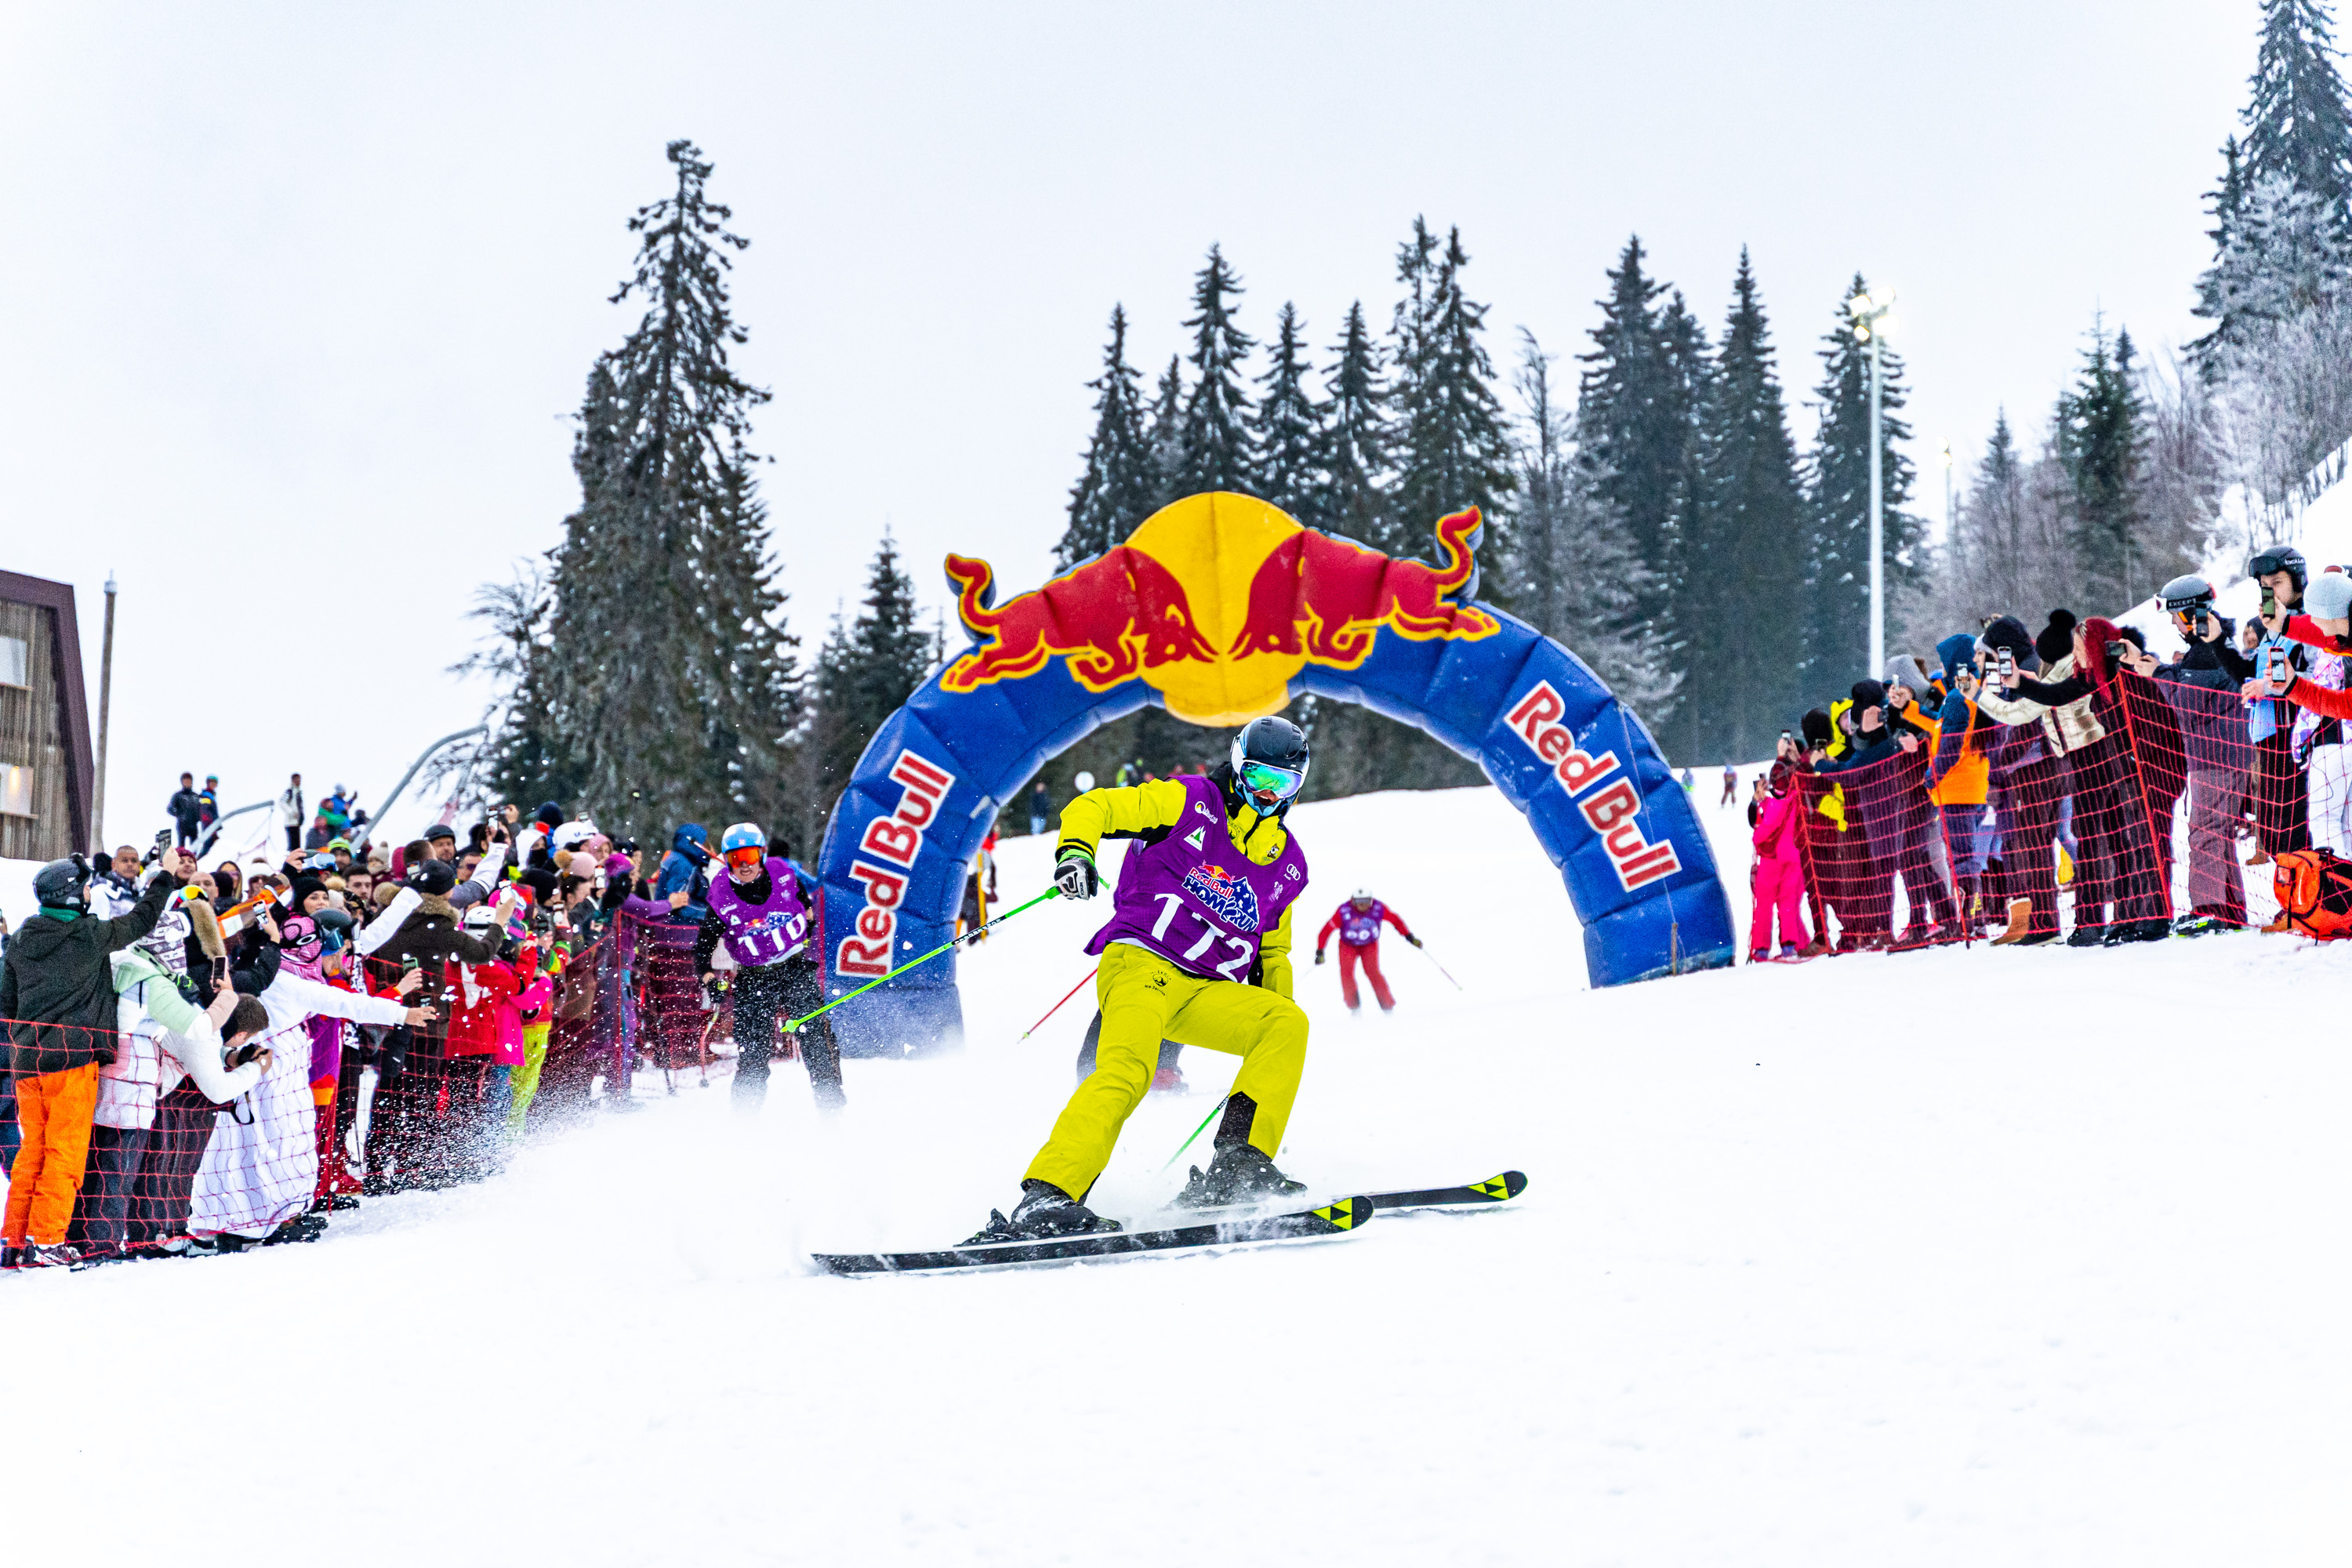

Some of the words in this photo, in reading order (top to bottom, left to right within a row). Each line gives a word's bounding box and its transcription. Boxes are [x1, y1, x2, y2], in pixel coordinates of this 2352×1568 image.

[862, 751, 953, 866] Bull
[1507, 683, 1618, 796] Red
[1581, 779, 1679, 890] Bull
[838, 862, 906, 977] Red
[1189, 867, 1211, 886] Red
[1210, 880, 1234, 898] Bull
